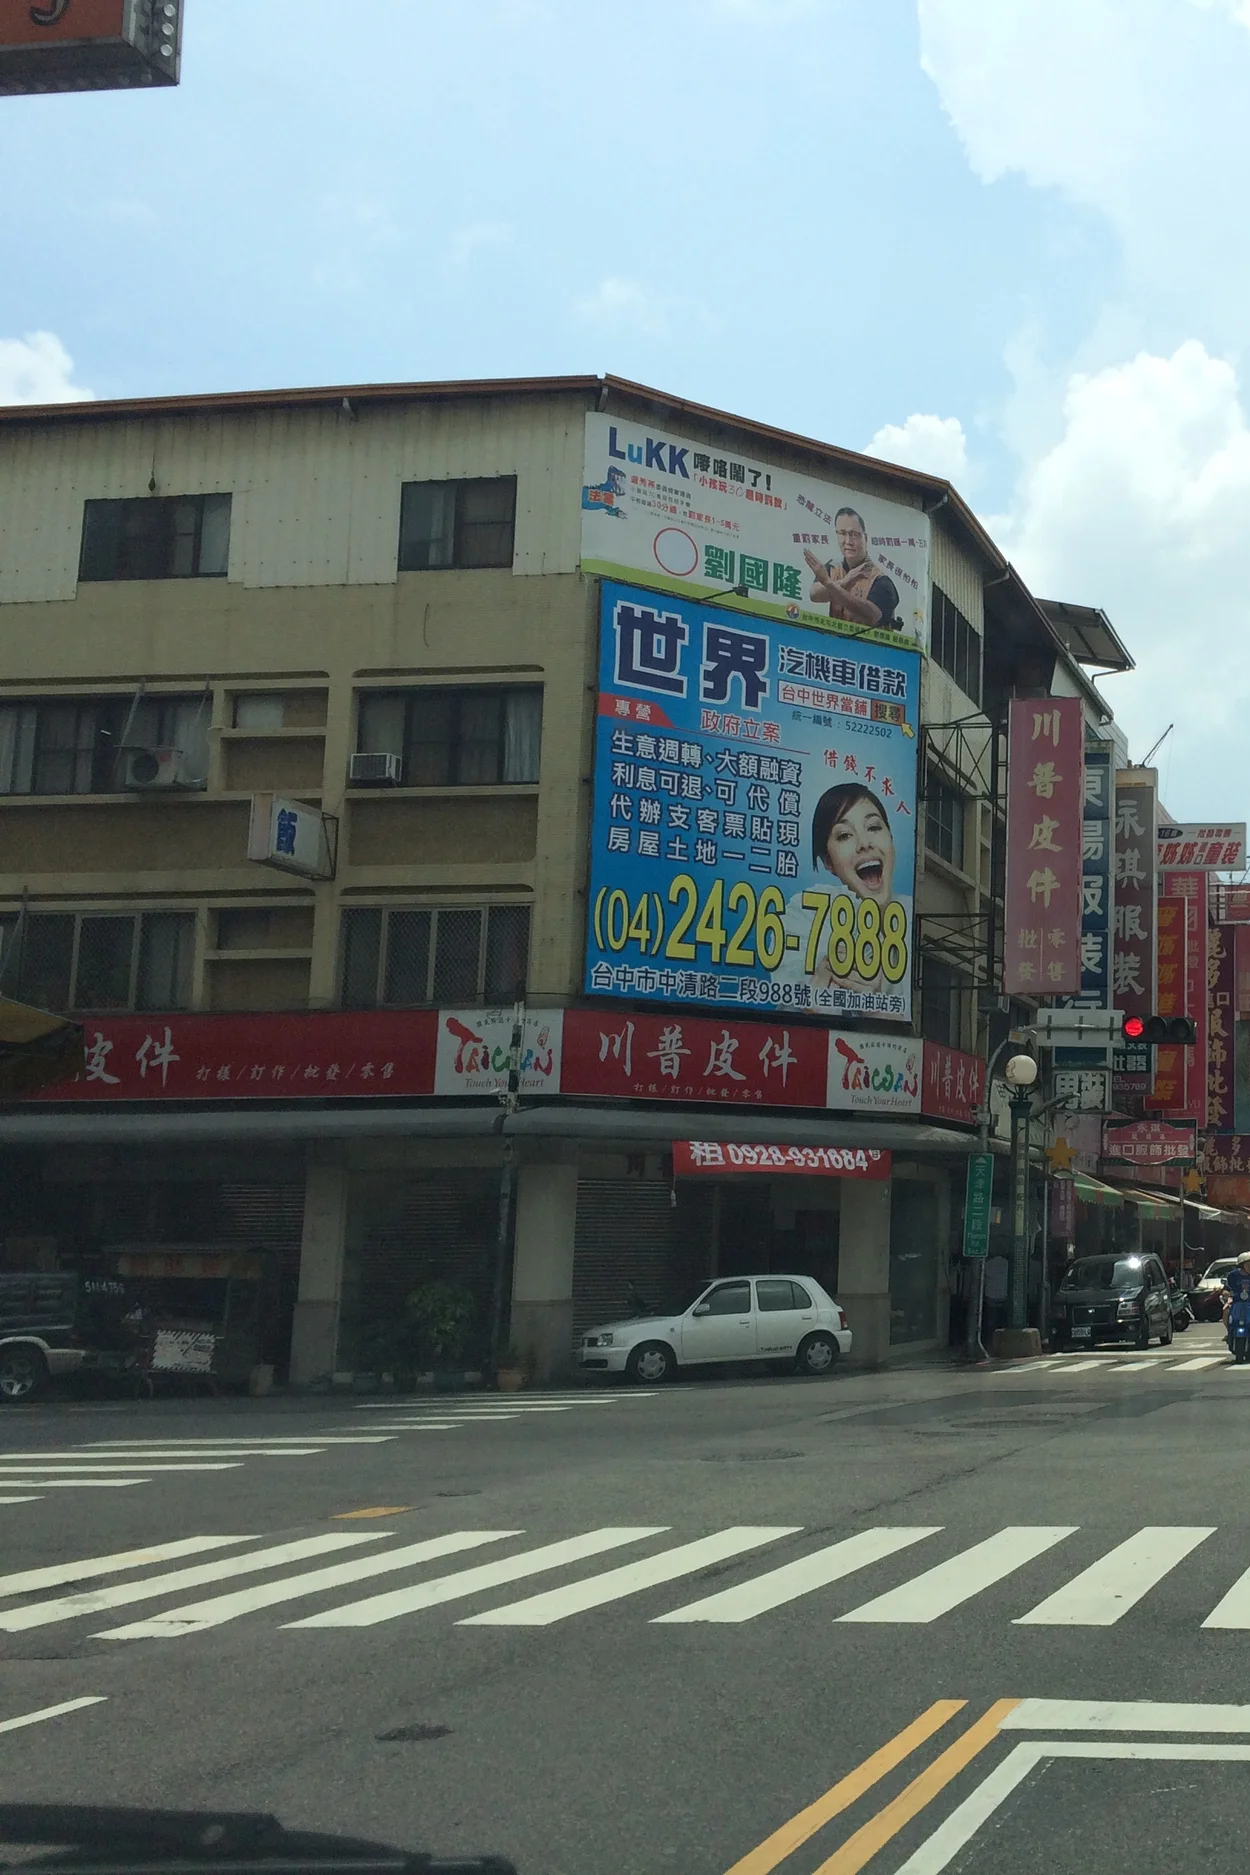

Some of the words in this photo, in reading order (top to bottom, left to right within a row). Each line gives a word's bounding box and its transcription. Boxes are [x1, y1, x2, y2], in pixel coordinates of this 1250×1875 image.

[704, 544, 803, 601] 劉國隆
[612, 600, 770, 713] 世界
[778, 645, 907, 698] 汽機車借款
[613, 699, 652, 722] 專營
[701, 709, 781, 744] 政府立案
[611, 730, 803, 787] 生意週轉、大額融資
[823, 749, 911, 815] 借錢不求人
[609, 793, 800, 847] 代辦支客票貼現
[1026, 709, 1064, 909] 川普皮件
[607, 826, 799, 878] 房屋土地一二胎
[593, 874, 908, 984] (04)2426-7888
[1047, 928, 1067, 982] 零售
[598, 1020, 799, 1088] 川普皮件
[930, 1050, 980, 1104] 川普皮件
[465, 1078, 492, 1089] Touch
[851, 1094, 873, 1104] Touch
[873, 1095, 891, 1106] Your
[891, 1097, 912, 1107] Heart
[689, 1140, 726, 1166] 租
[1108, 1143, 1190, 1157] 進口服飾批發
